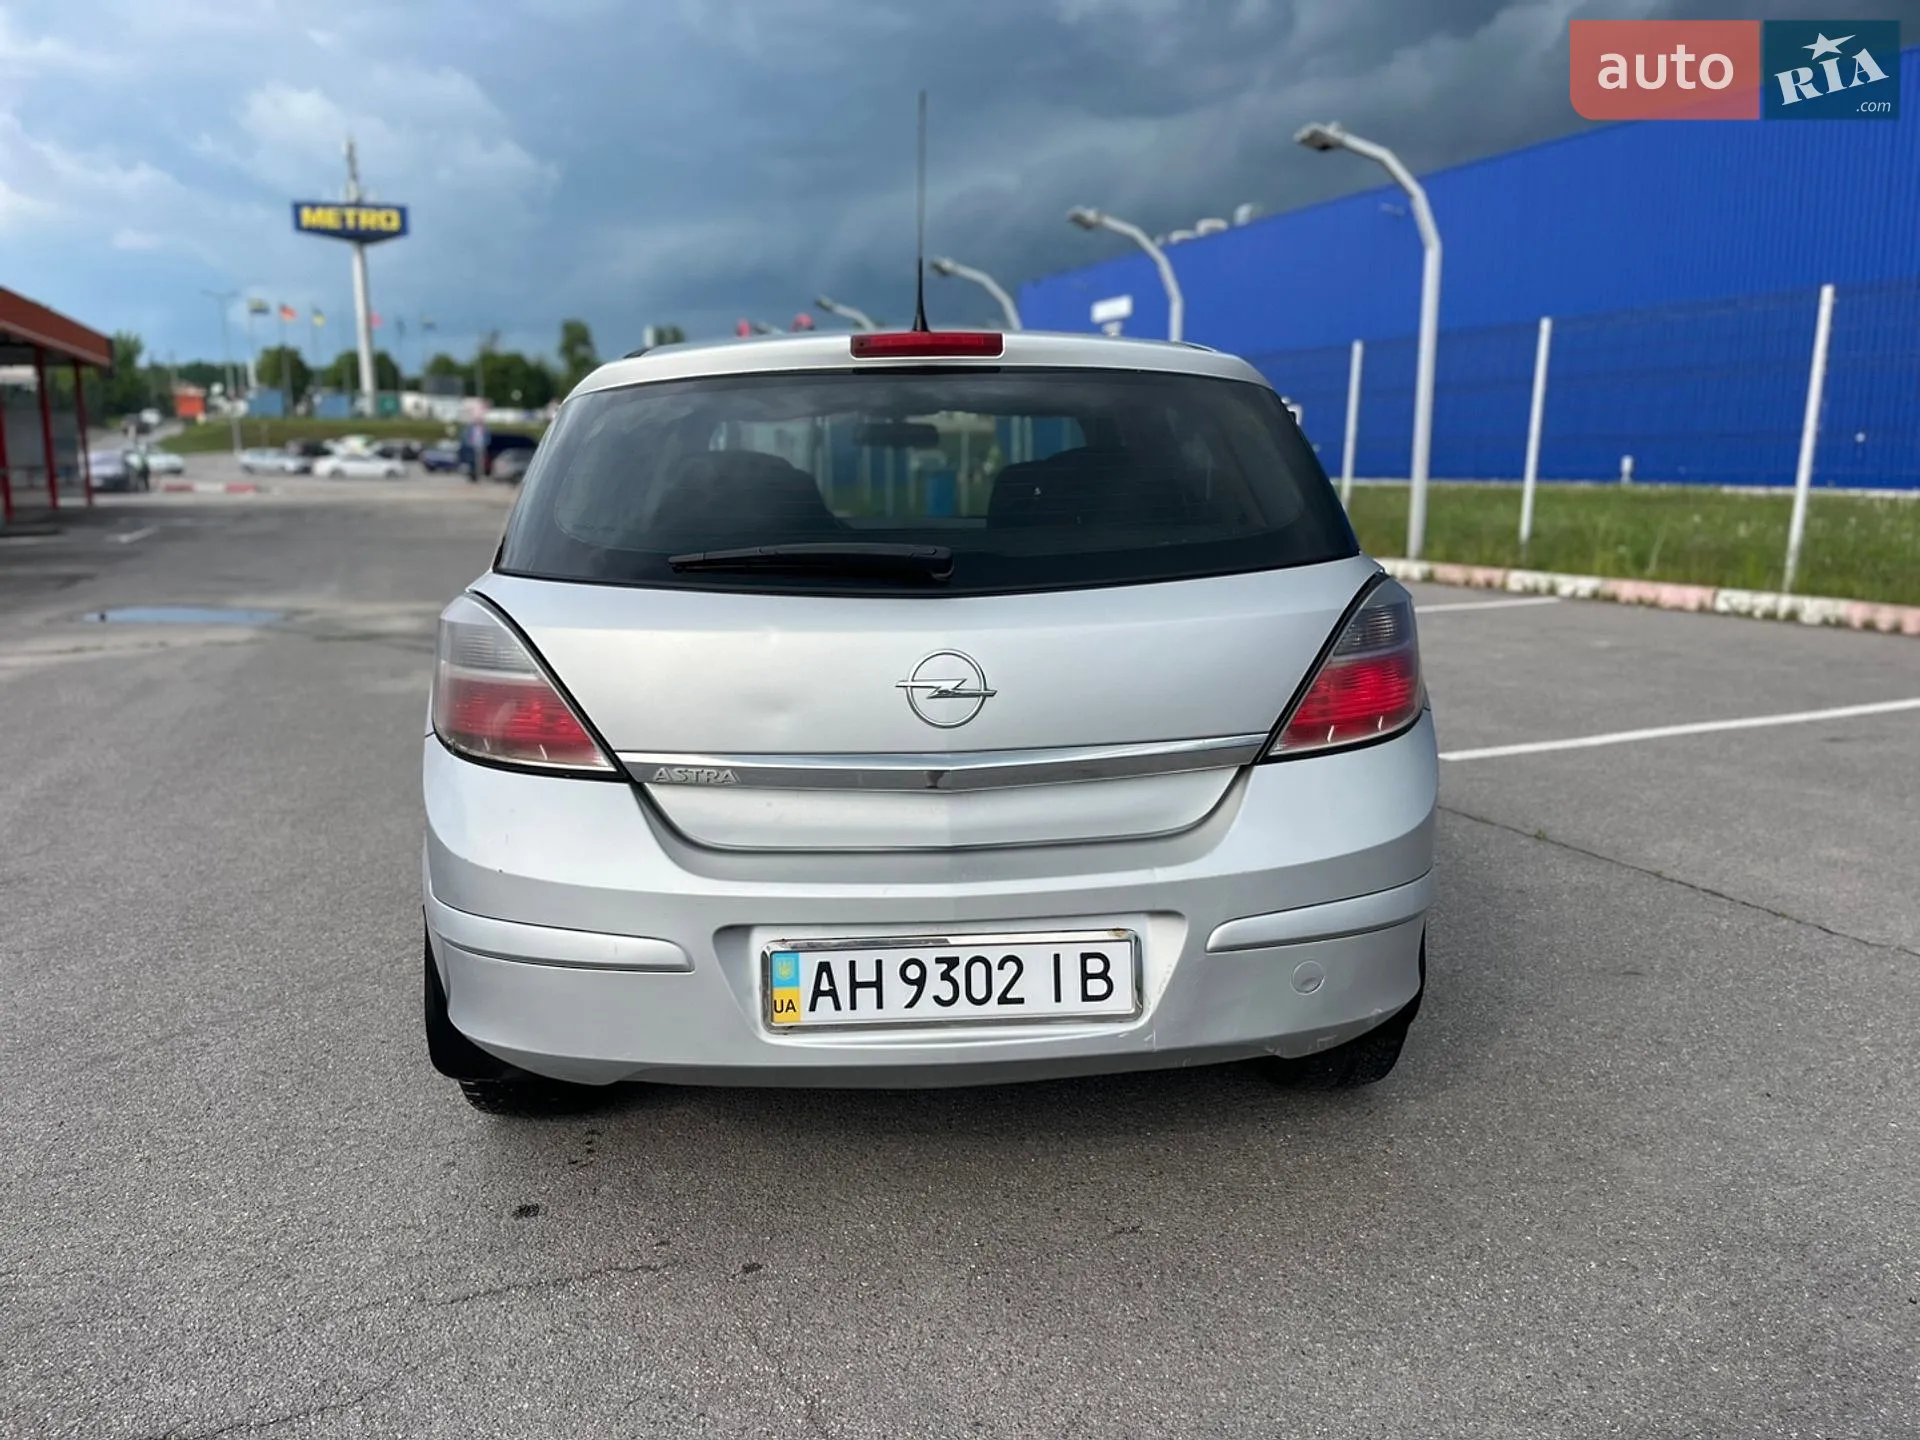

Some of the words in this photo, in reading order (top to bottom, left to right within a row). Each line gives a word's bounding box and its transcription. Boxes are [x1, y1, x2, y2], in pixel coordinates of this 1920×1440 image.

[300, 206, 402, 232] METRO
[653, 767, 740, 785] ASTRA
[808, 958, 884, 1013] AH
[899, 953, 1025, 1010] 9302
[1052, 951, 1115, 1004] IB
[773, 1000, 797, 1015] UA
